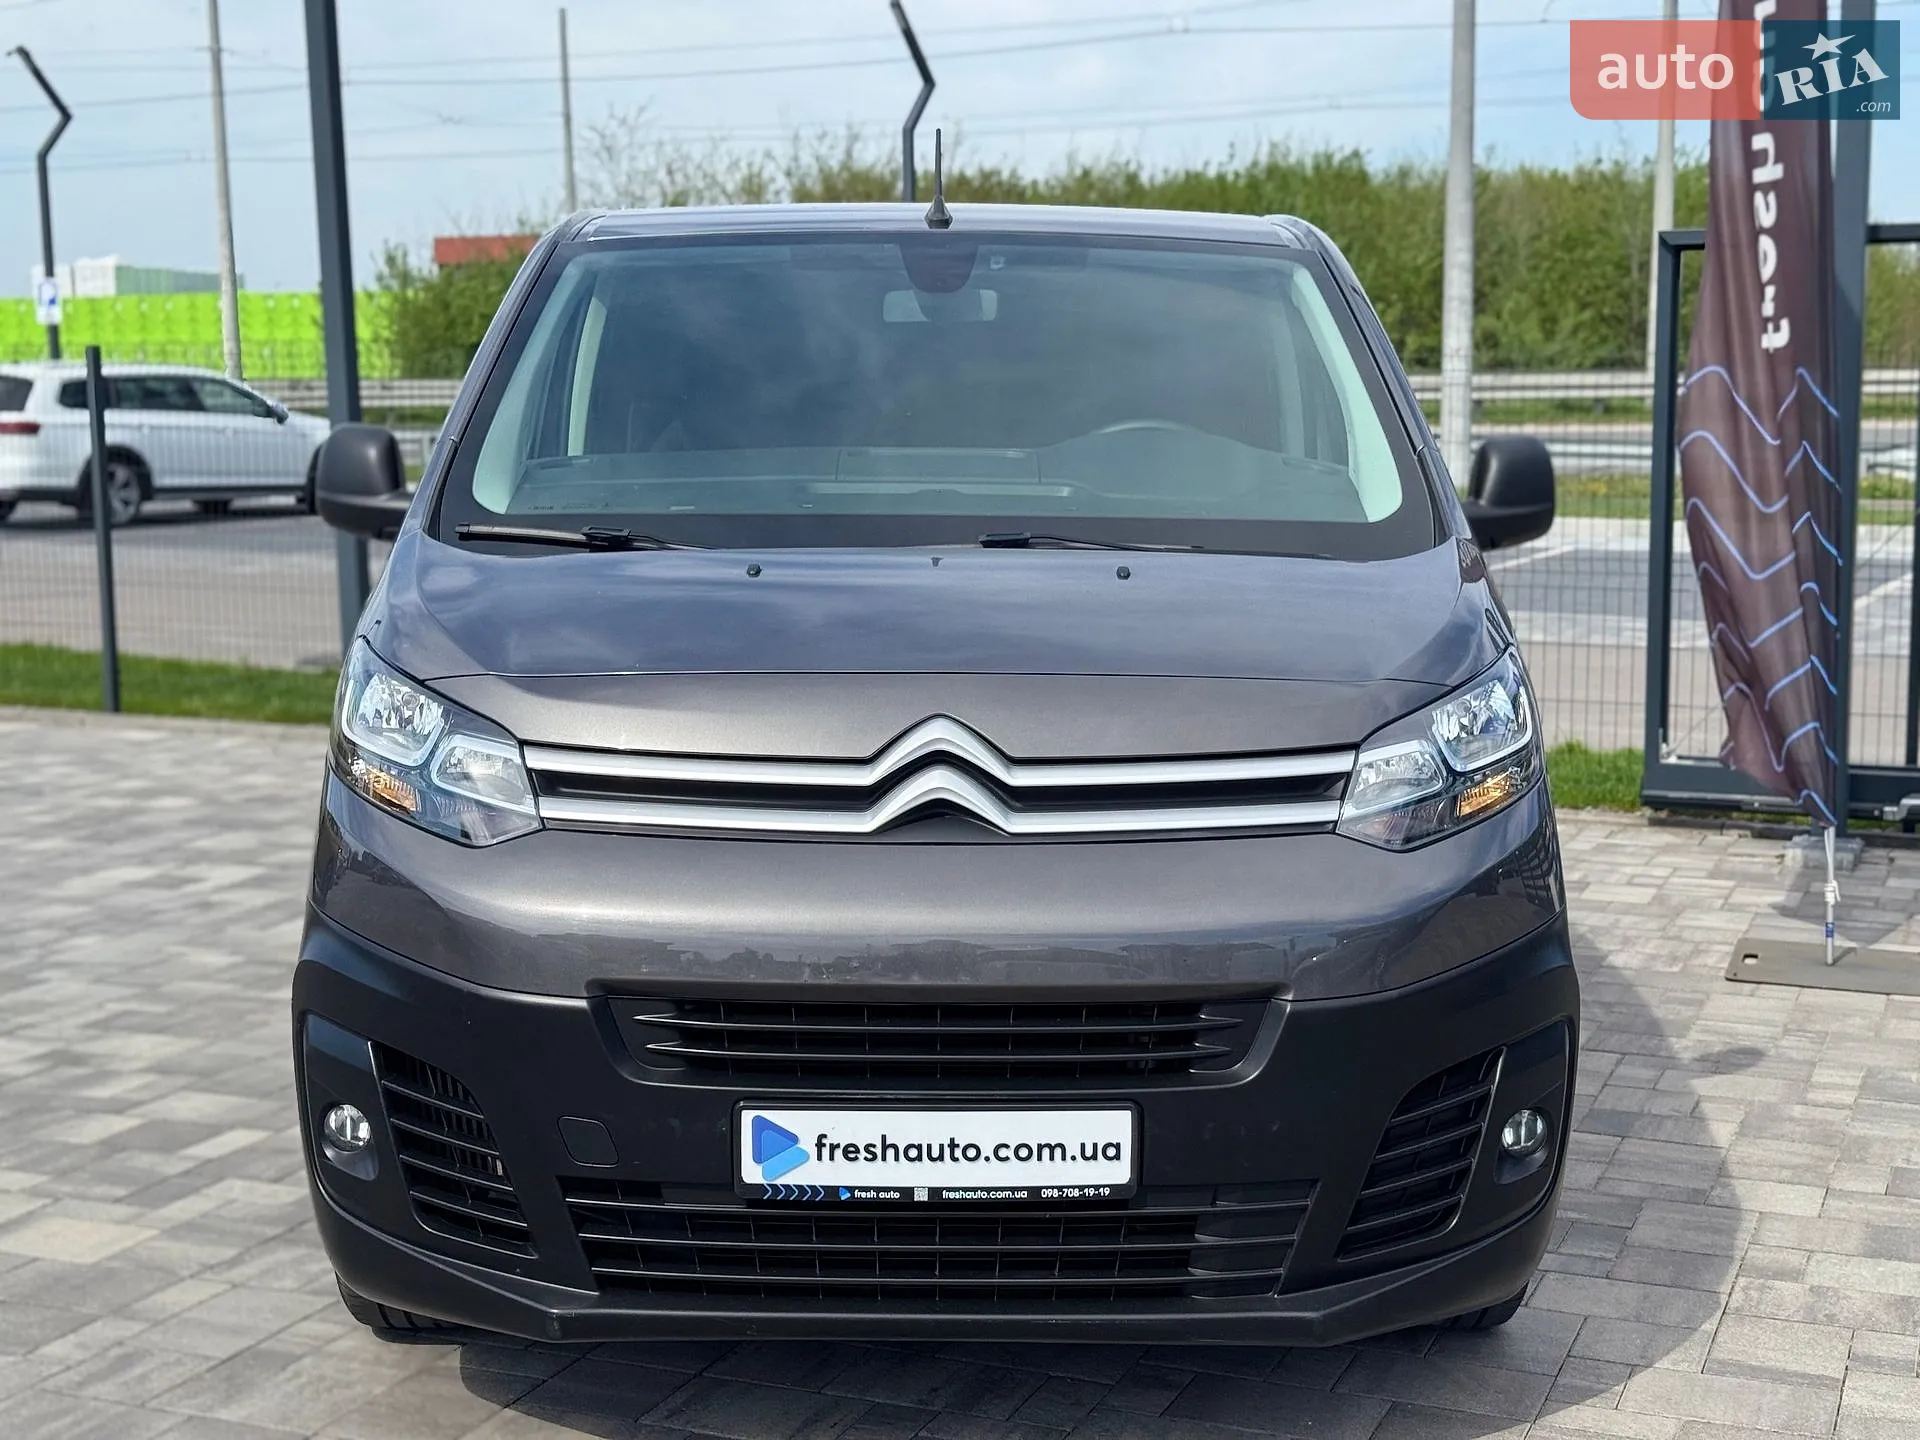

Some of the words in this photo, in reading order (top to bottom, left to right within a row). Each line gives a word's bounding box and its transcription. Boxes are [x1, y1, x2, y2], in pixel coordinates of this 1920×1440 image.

[814, 1133, 1122, 1163] freshauto.com.ua
[854, 1188, 877, 1199] fresh
[878, 1190, 901, 1200] auto
[942, 1188, 1028, 1200] freshauto.com.ua
[1041, 1187, 1111, 1199] 098-708-19-19
